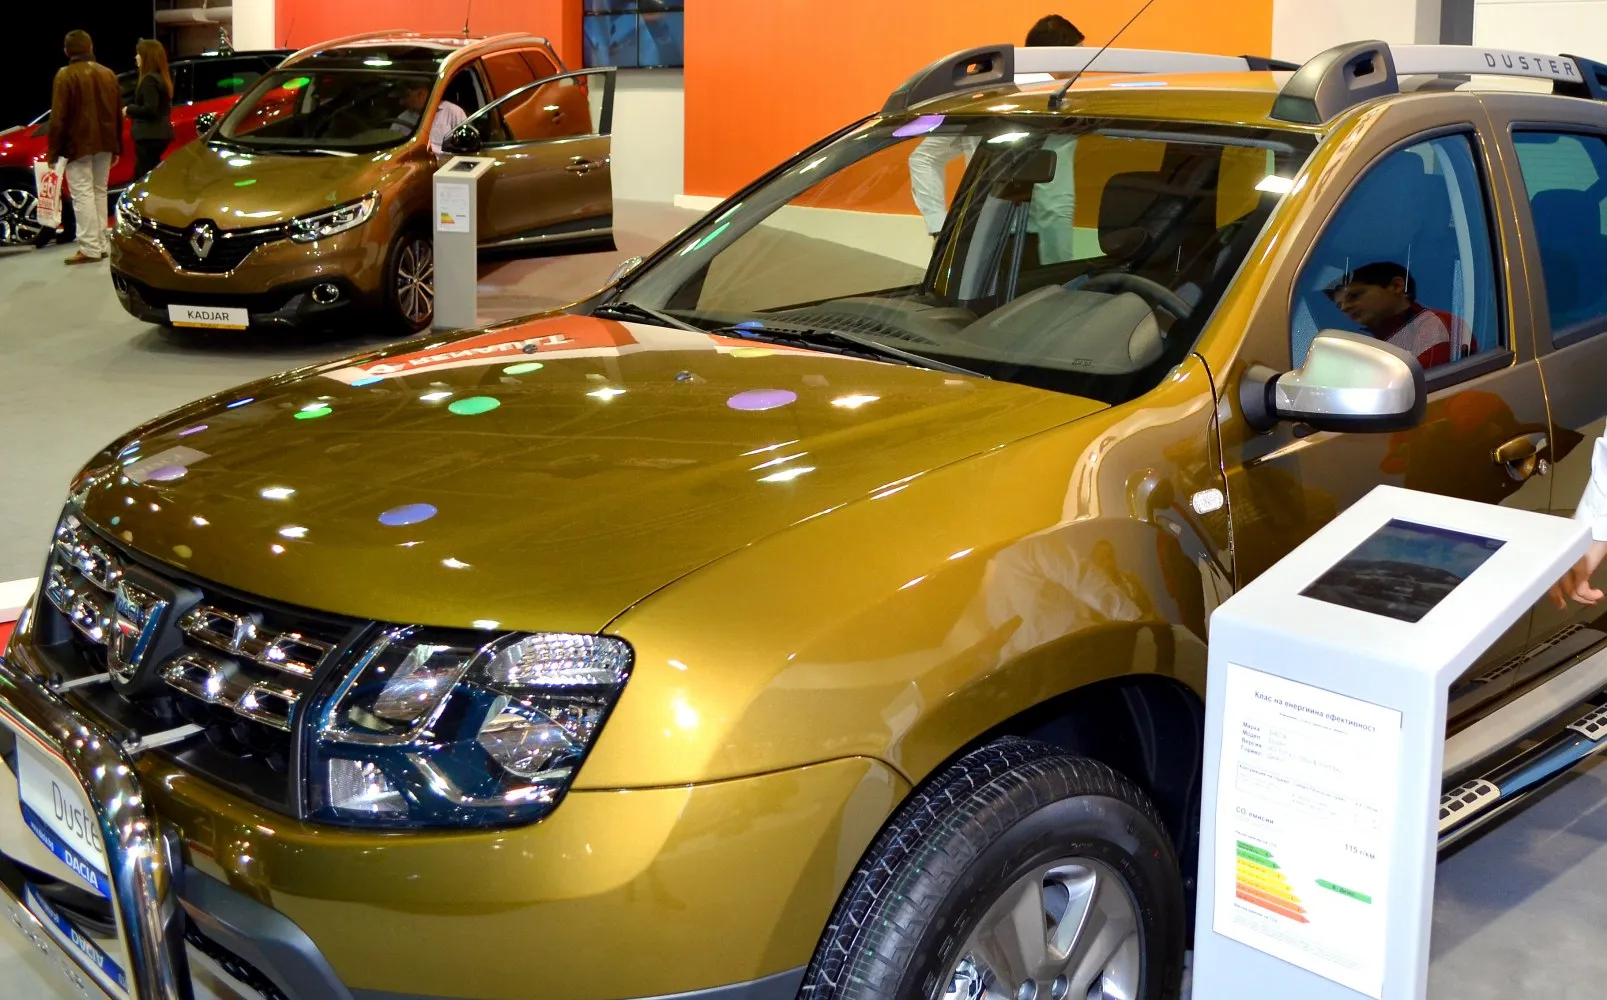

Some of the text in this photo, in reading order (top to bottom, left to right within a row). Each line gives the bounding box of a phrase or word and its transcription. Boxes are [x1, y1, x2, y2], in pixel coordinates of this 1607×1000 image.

[1483, 52, 1576, 77] DUSTER
[187, 309, 230, 321] KADJAR
[1254, 689, 1272, 702] Клас
[52, 780, 103, 853] Duste
[64, 850, 99, 889] DACIA
